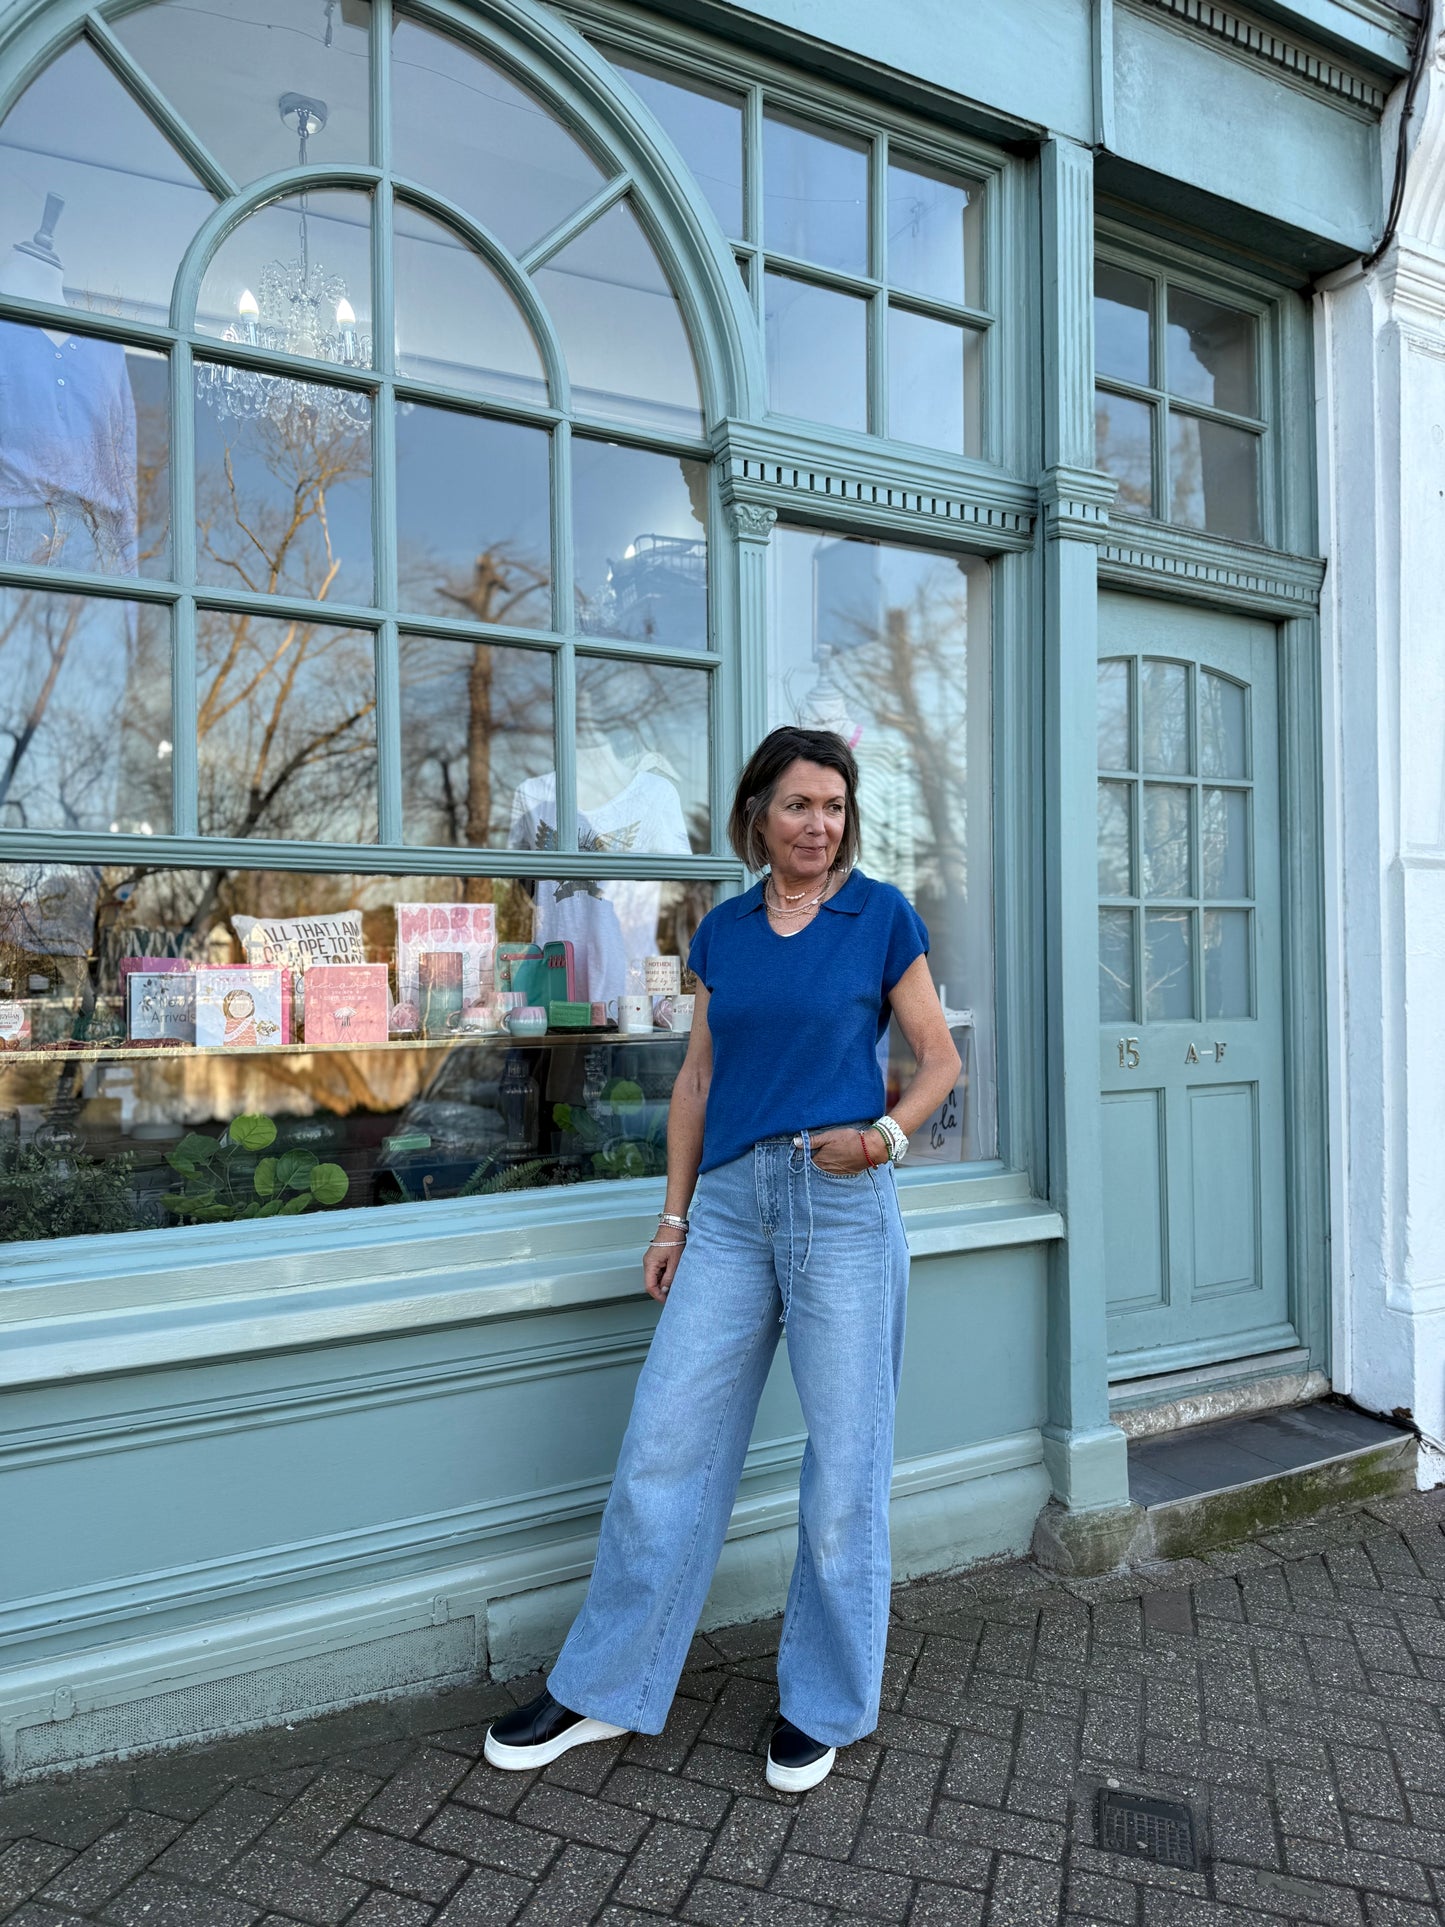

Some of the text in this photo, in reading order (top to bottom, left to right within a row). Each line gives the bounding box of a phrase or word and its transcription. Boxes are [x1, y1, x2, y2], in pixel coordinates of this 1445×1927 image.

[292, 922, 331, 939] THAT
[332, 922, 341, 936] I
[341, 921, 360, 937] AM
[401, 907, 493, 944] MORE
[328, 937, 348, 953] TO
[151, 1010, 196, 1023] Arrivals
[1117, 1037, 1140, 1069] 15
[939, 1103, 958, 1130] la
[930, 1122, 945, 1150] la
